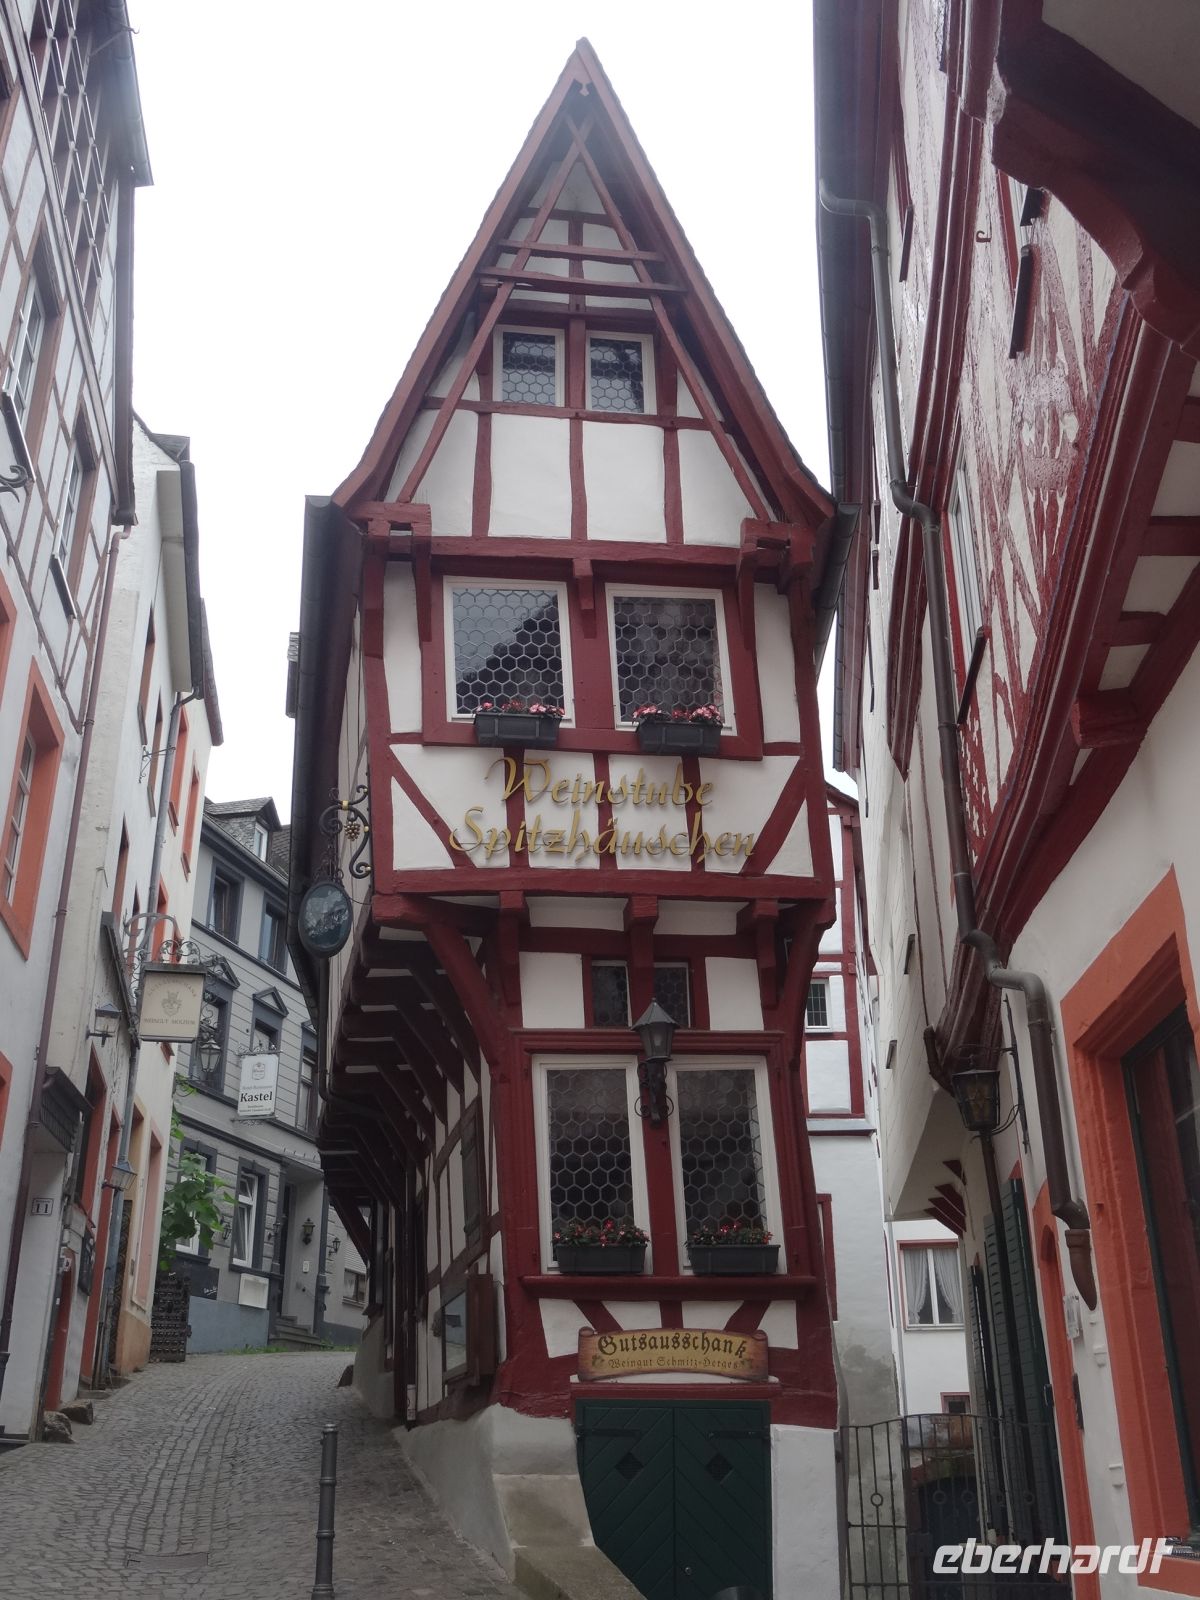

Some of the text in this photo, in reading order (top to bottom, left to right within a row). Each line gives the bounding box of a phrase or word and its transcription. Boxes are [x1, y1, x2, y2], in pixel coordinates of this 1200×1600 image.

[484, 756, 715, 806] Weinstube
[448, 806, 756, 863] Spitzhäuschen
[240, 1091, 273, 1103] Kastel
[35, 1203, 49, 1214] 11
[597, 1331, 748, 1359] Gutsausschank
[608, 1358, 653, 1369] Weingut
